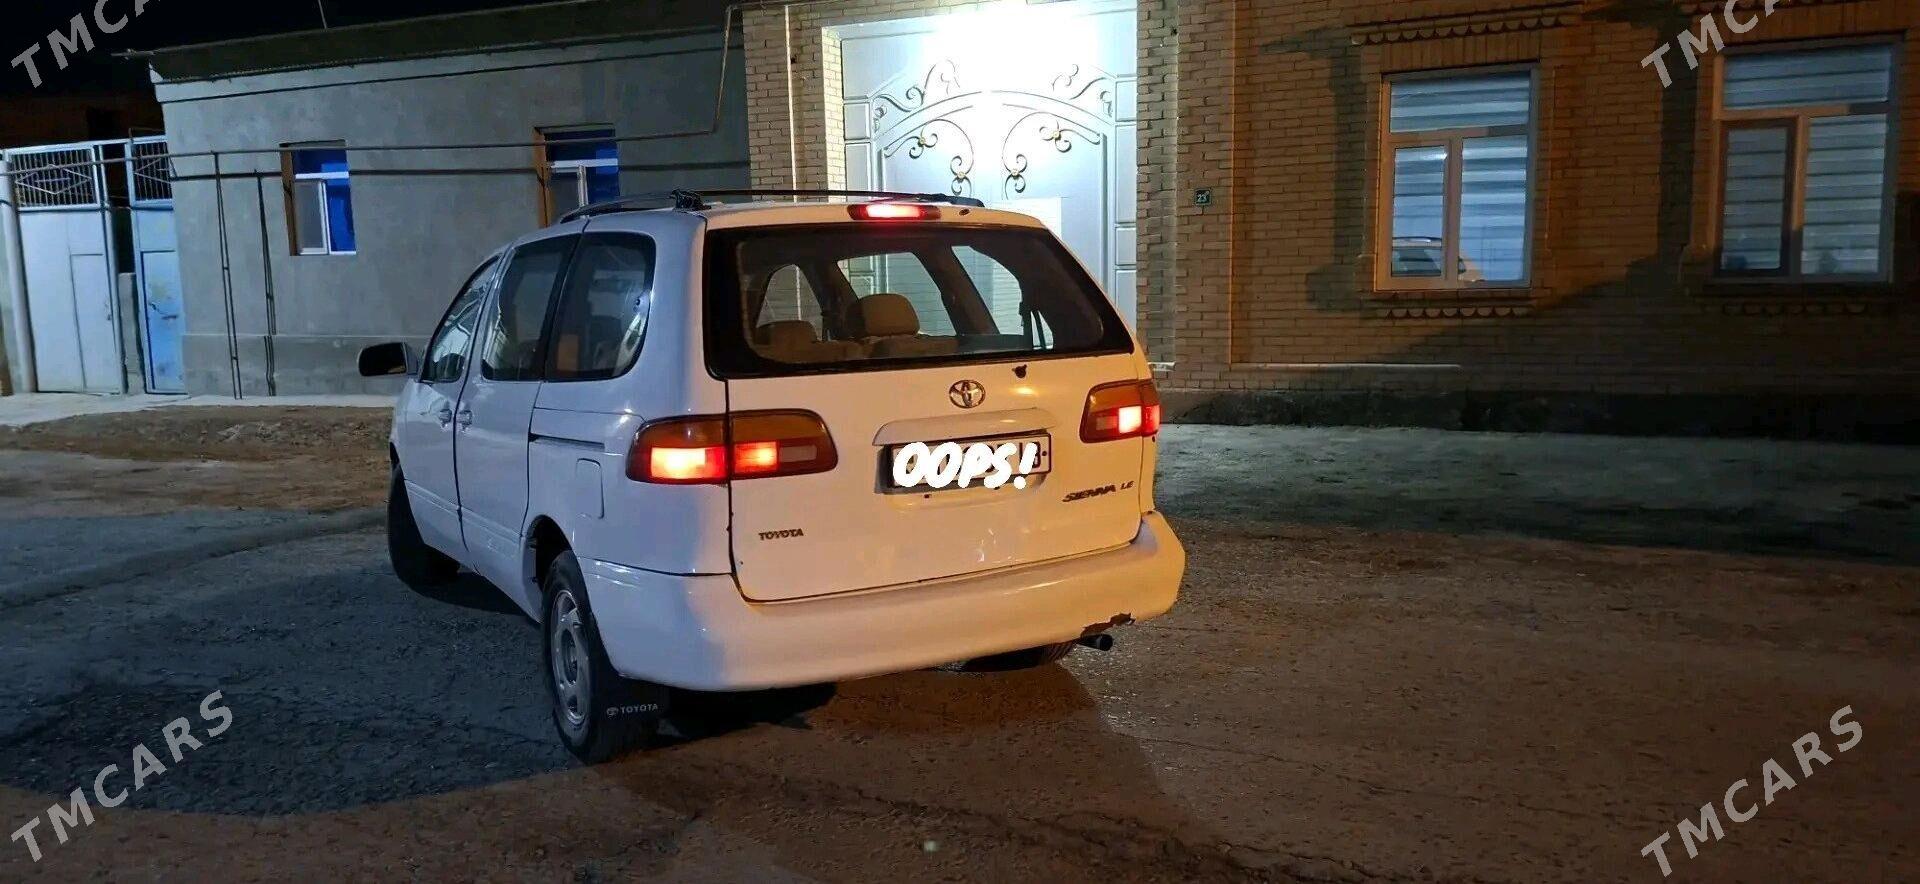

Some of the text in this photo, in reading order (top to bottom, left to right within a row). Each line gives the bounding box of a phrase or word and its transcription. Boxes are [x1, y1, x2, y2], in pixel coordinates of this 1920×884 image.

[1062, 480, 1134, 502] SIENNA LE
[758, 528, 804, 541] TOYOTA
[620, 703, 659, 714] TOYOTA
